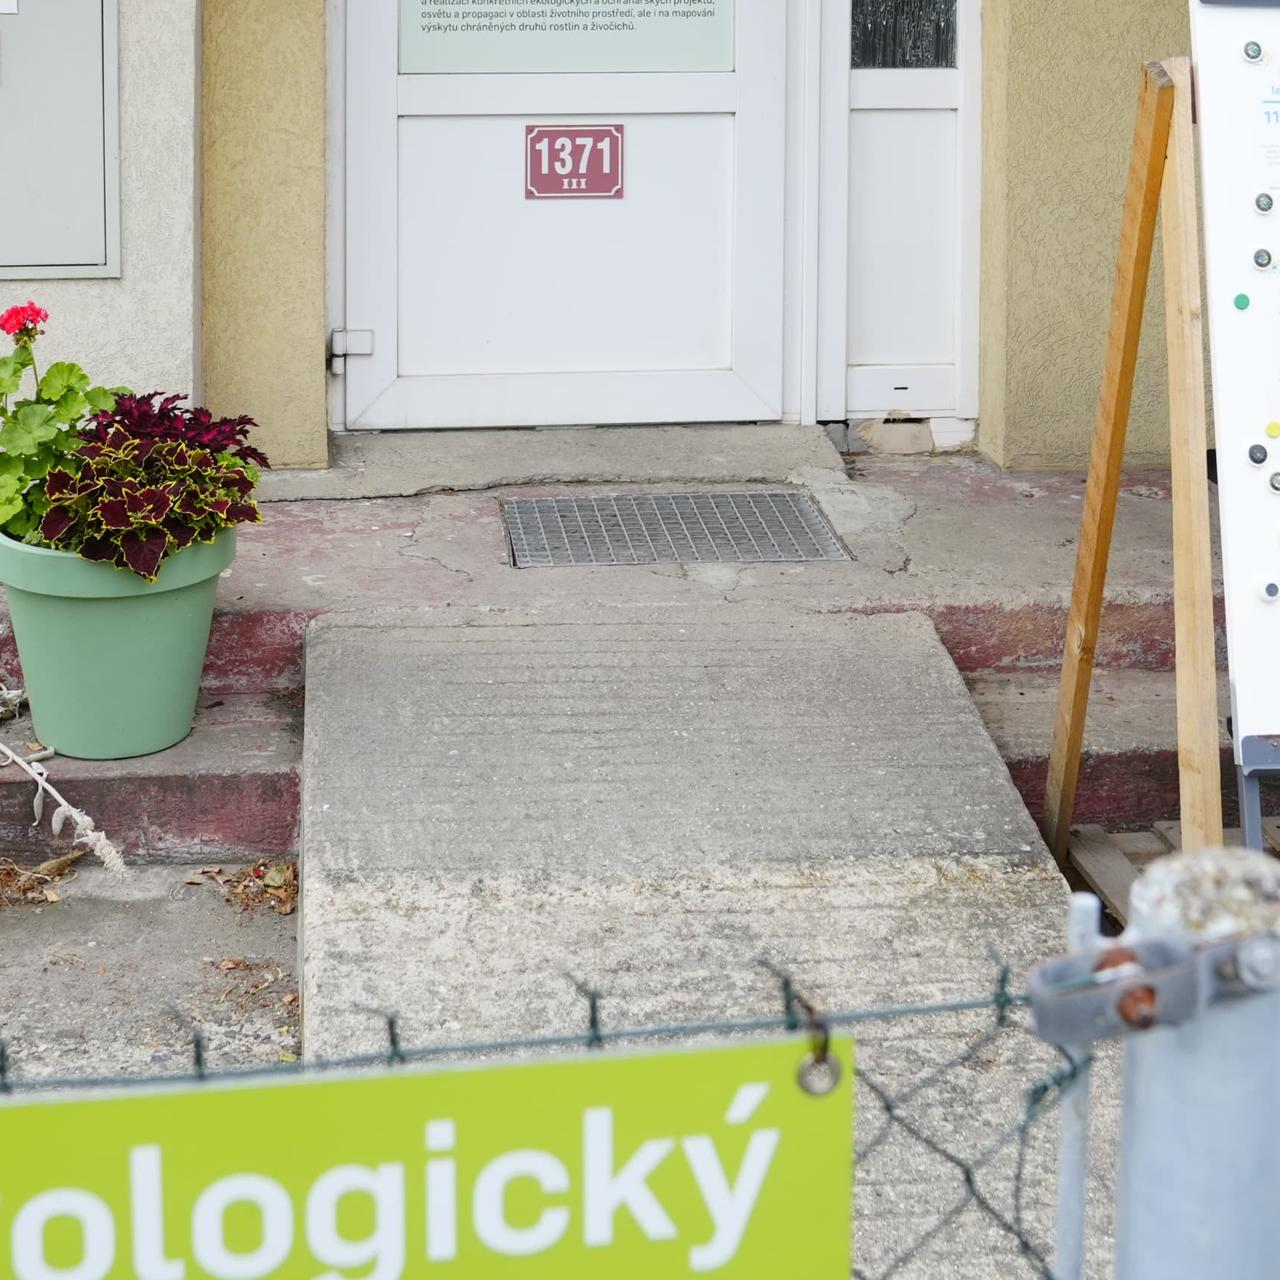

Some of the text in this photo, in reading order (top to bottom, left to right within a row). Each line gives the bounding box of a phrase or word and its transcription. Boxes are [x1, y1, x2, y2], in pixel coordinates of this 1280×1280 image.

[421, 9, 452, 19] osvětu
[461, 7, 507, 20] propagaci
[516, 9, 547, 18] oblasti
[549, 8, 590, 18] životního
[637, 8, 652, 18] ale
[671, 8, 715, 19] mapování
[421, 22, 458, 33] výskytu
[460, 22, 516, 33] chráněných
[518, 21, 547, 32] druhů
[549, 22, 580, 31] rostlin
[535, 137, 610, 175] 1371
[562, 179, 587, 189] III
